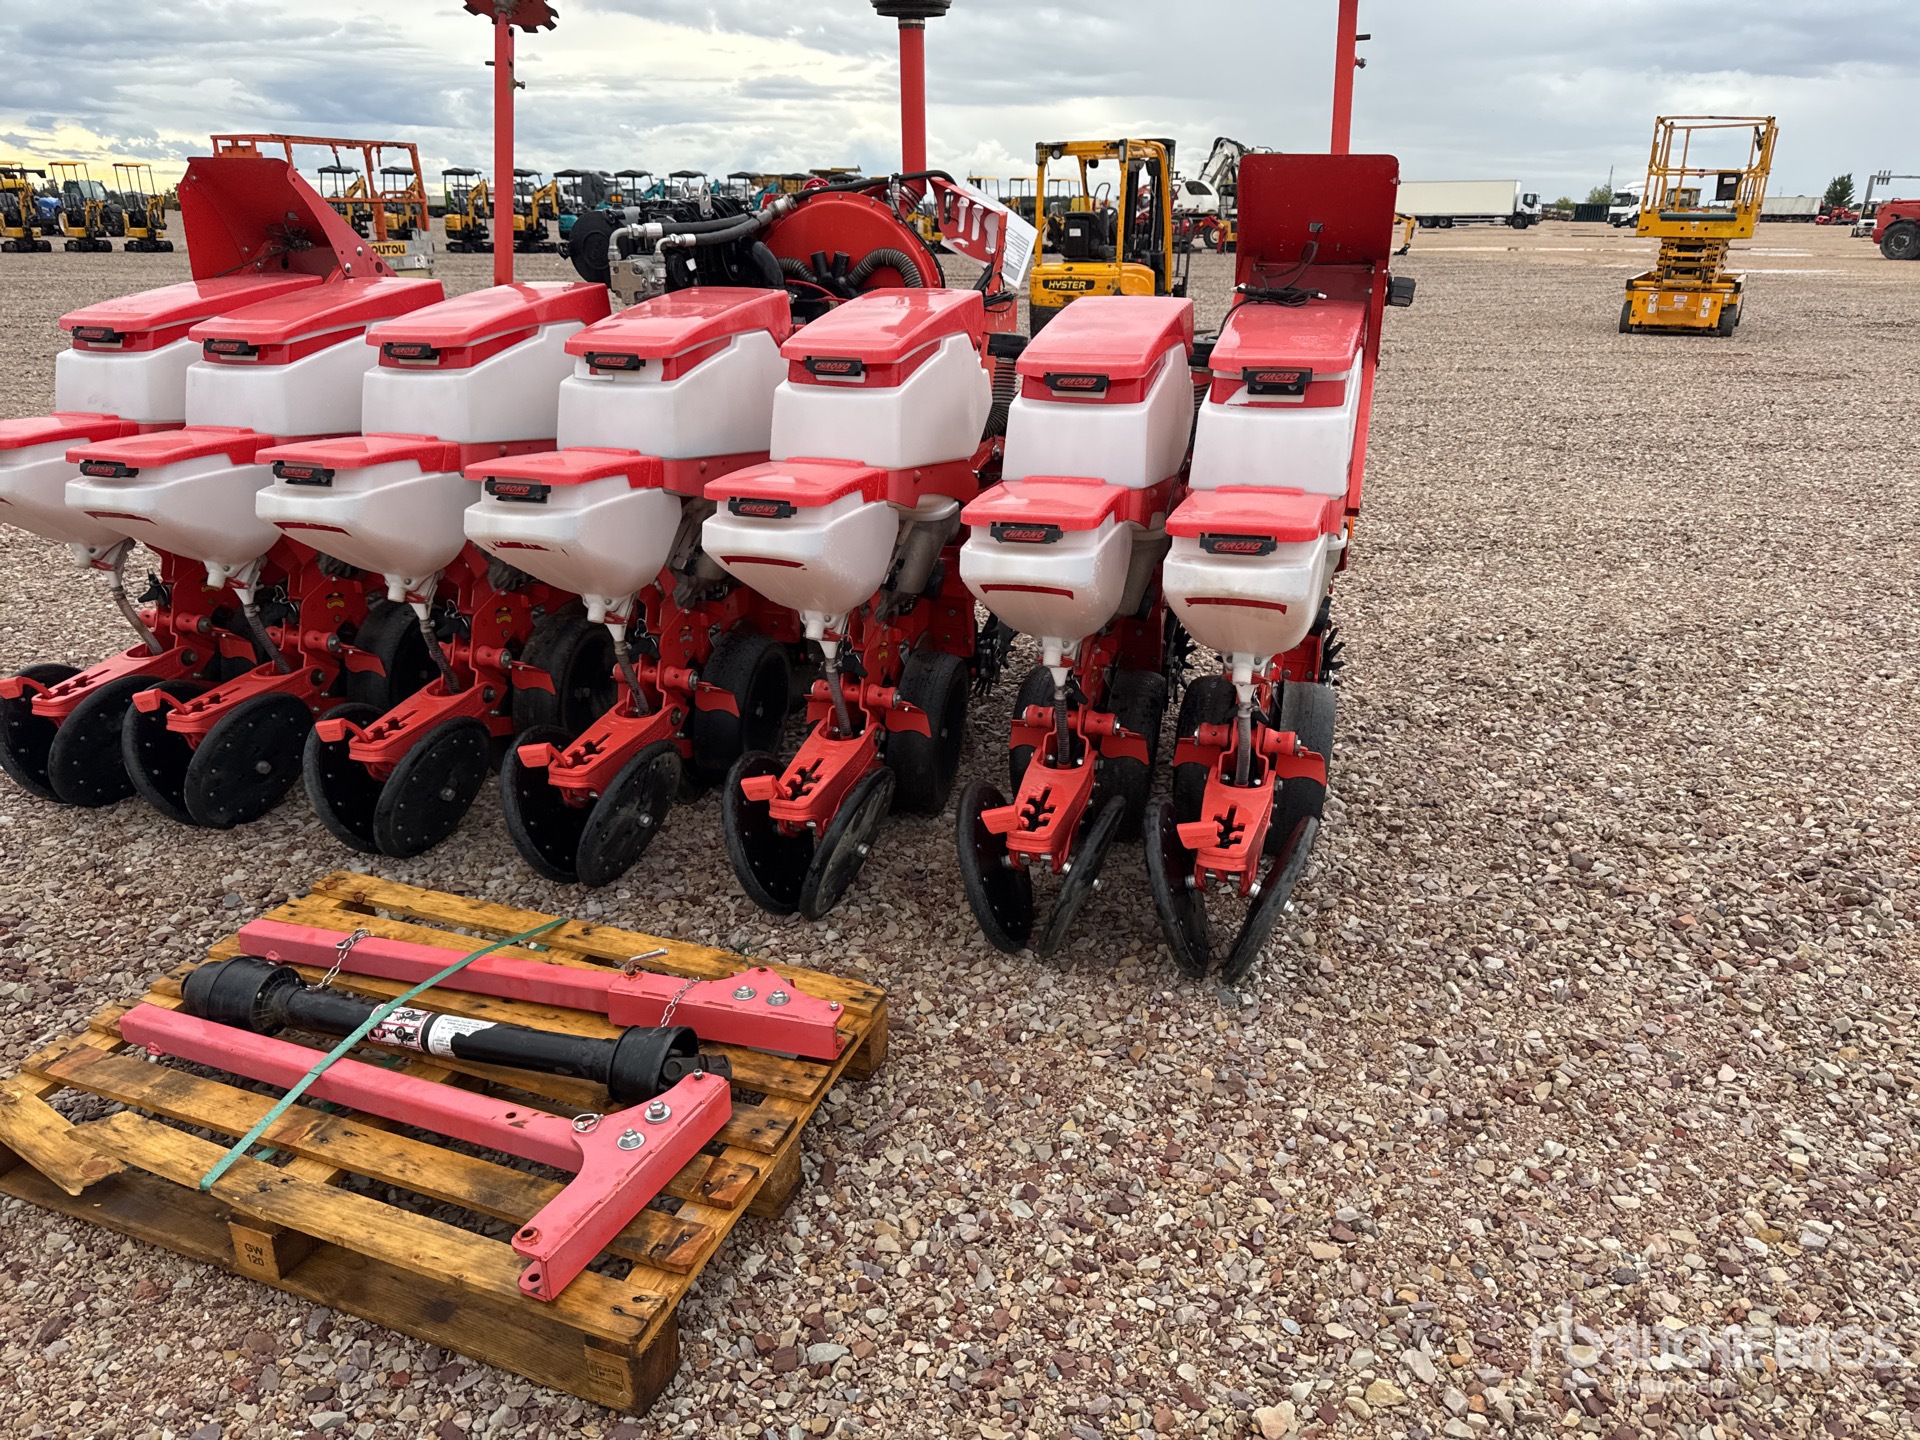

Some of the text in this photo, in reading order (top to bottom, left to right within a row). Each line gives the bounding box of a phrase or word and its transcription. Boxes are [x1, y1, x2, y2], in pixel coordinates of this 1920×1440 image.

[1048, 280, 1087, 290] HYSTER
[78, 329, 105, 337] CHRONO
[211, 343, 240, 353] CHRONO
[391, 346, 421, 356] CHRONO
[594, 356, 628, 366] CHRONO
[814, 362, 851, 371] CHRONO
[1056, 378, 1097, 388] CHRONO
[1255, 373, 1300, 383] CHRONO
[86, 465, 116, 476] CHRONO
[280, 467, 313, 478] CHRONO
[494, 484, 530, 494] CHRONO
[739, 504, 779, 514] CHRONO
[1002, 529, 1046, 540] CHRONO
[1213, 542, 1263, 552] CHRONO
[244, 1242, 263, 1256] GW
[246, 1254, 265, 1267] 120
